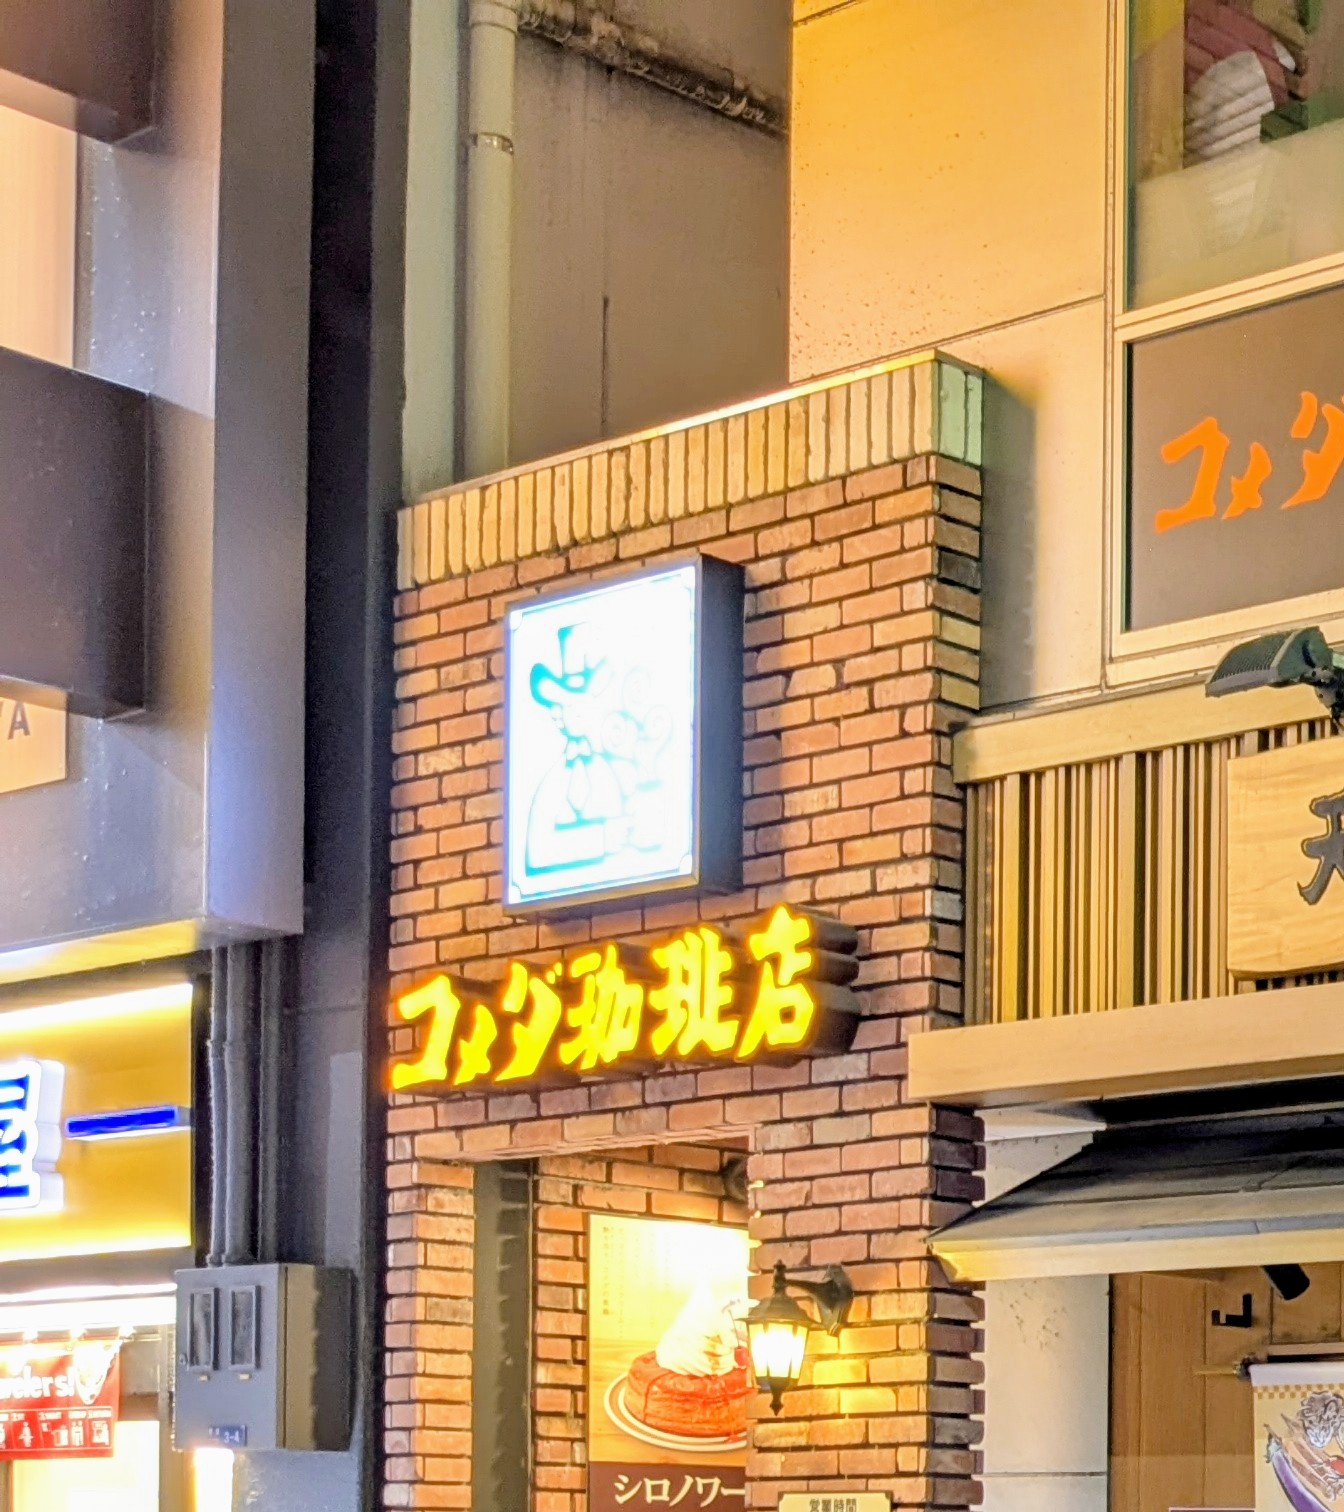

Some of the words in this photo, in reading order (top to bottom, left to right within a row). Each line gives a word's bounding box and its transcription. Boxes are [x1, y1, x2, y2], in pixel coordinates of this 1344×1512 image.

[391, 902, 818, 1092] コメダ珈琲店
